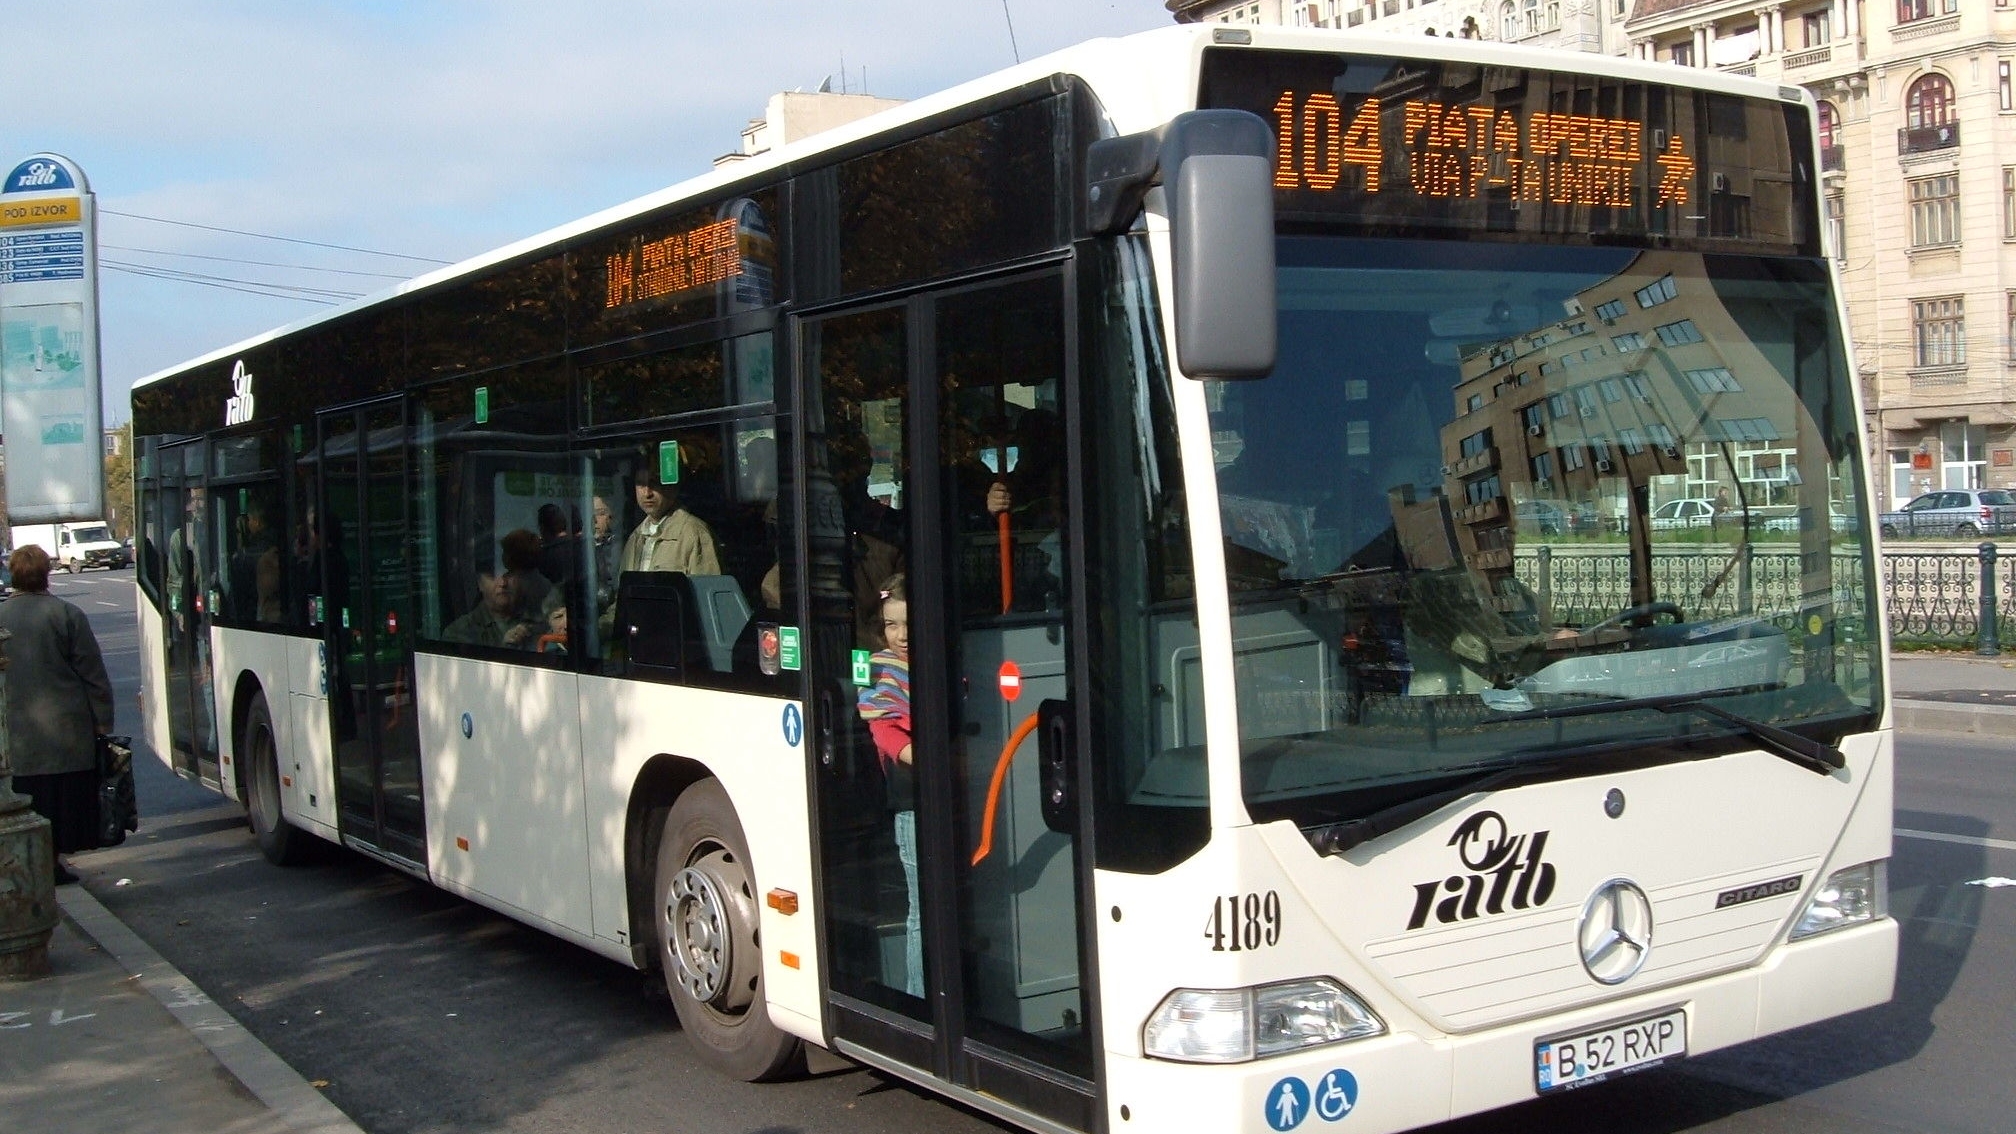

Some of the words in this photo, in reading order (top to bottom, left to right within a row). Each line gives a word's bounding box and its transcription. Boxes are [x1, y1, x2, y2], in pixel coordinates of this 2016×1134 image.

[1273, 91, 1382, 192] 104
[1405, 101, 1518, 152] PIATA
[1529, 112, 1642, 161] OPEREI
[1411, 151, 1461, 198] VIA
[1470, 155, 1541, 202] P-TA
[4, 207, 27, 219] POD
[31, 204, 68, 217] IZVOR
[1406, 812, 1557, 931] ratb
[1719, 878, 1801, 906] CITARO
[1204, 889, 1281, 952] 4189
[1558, 1044, 1577, 1078] B
[1586, 1035, 1615, 1071] 52
[1623, 1019, 1674, 1062] RXP
